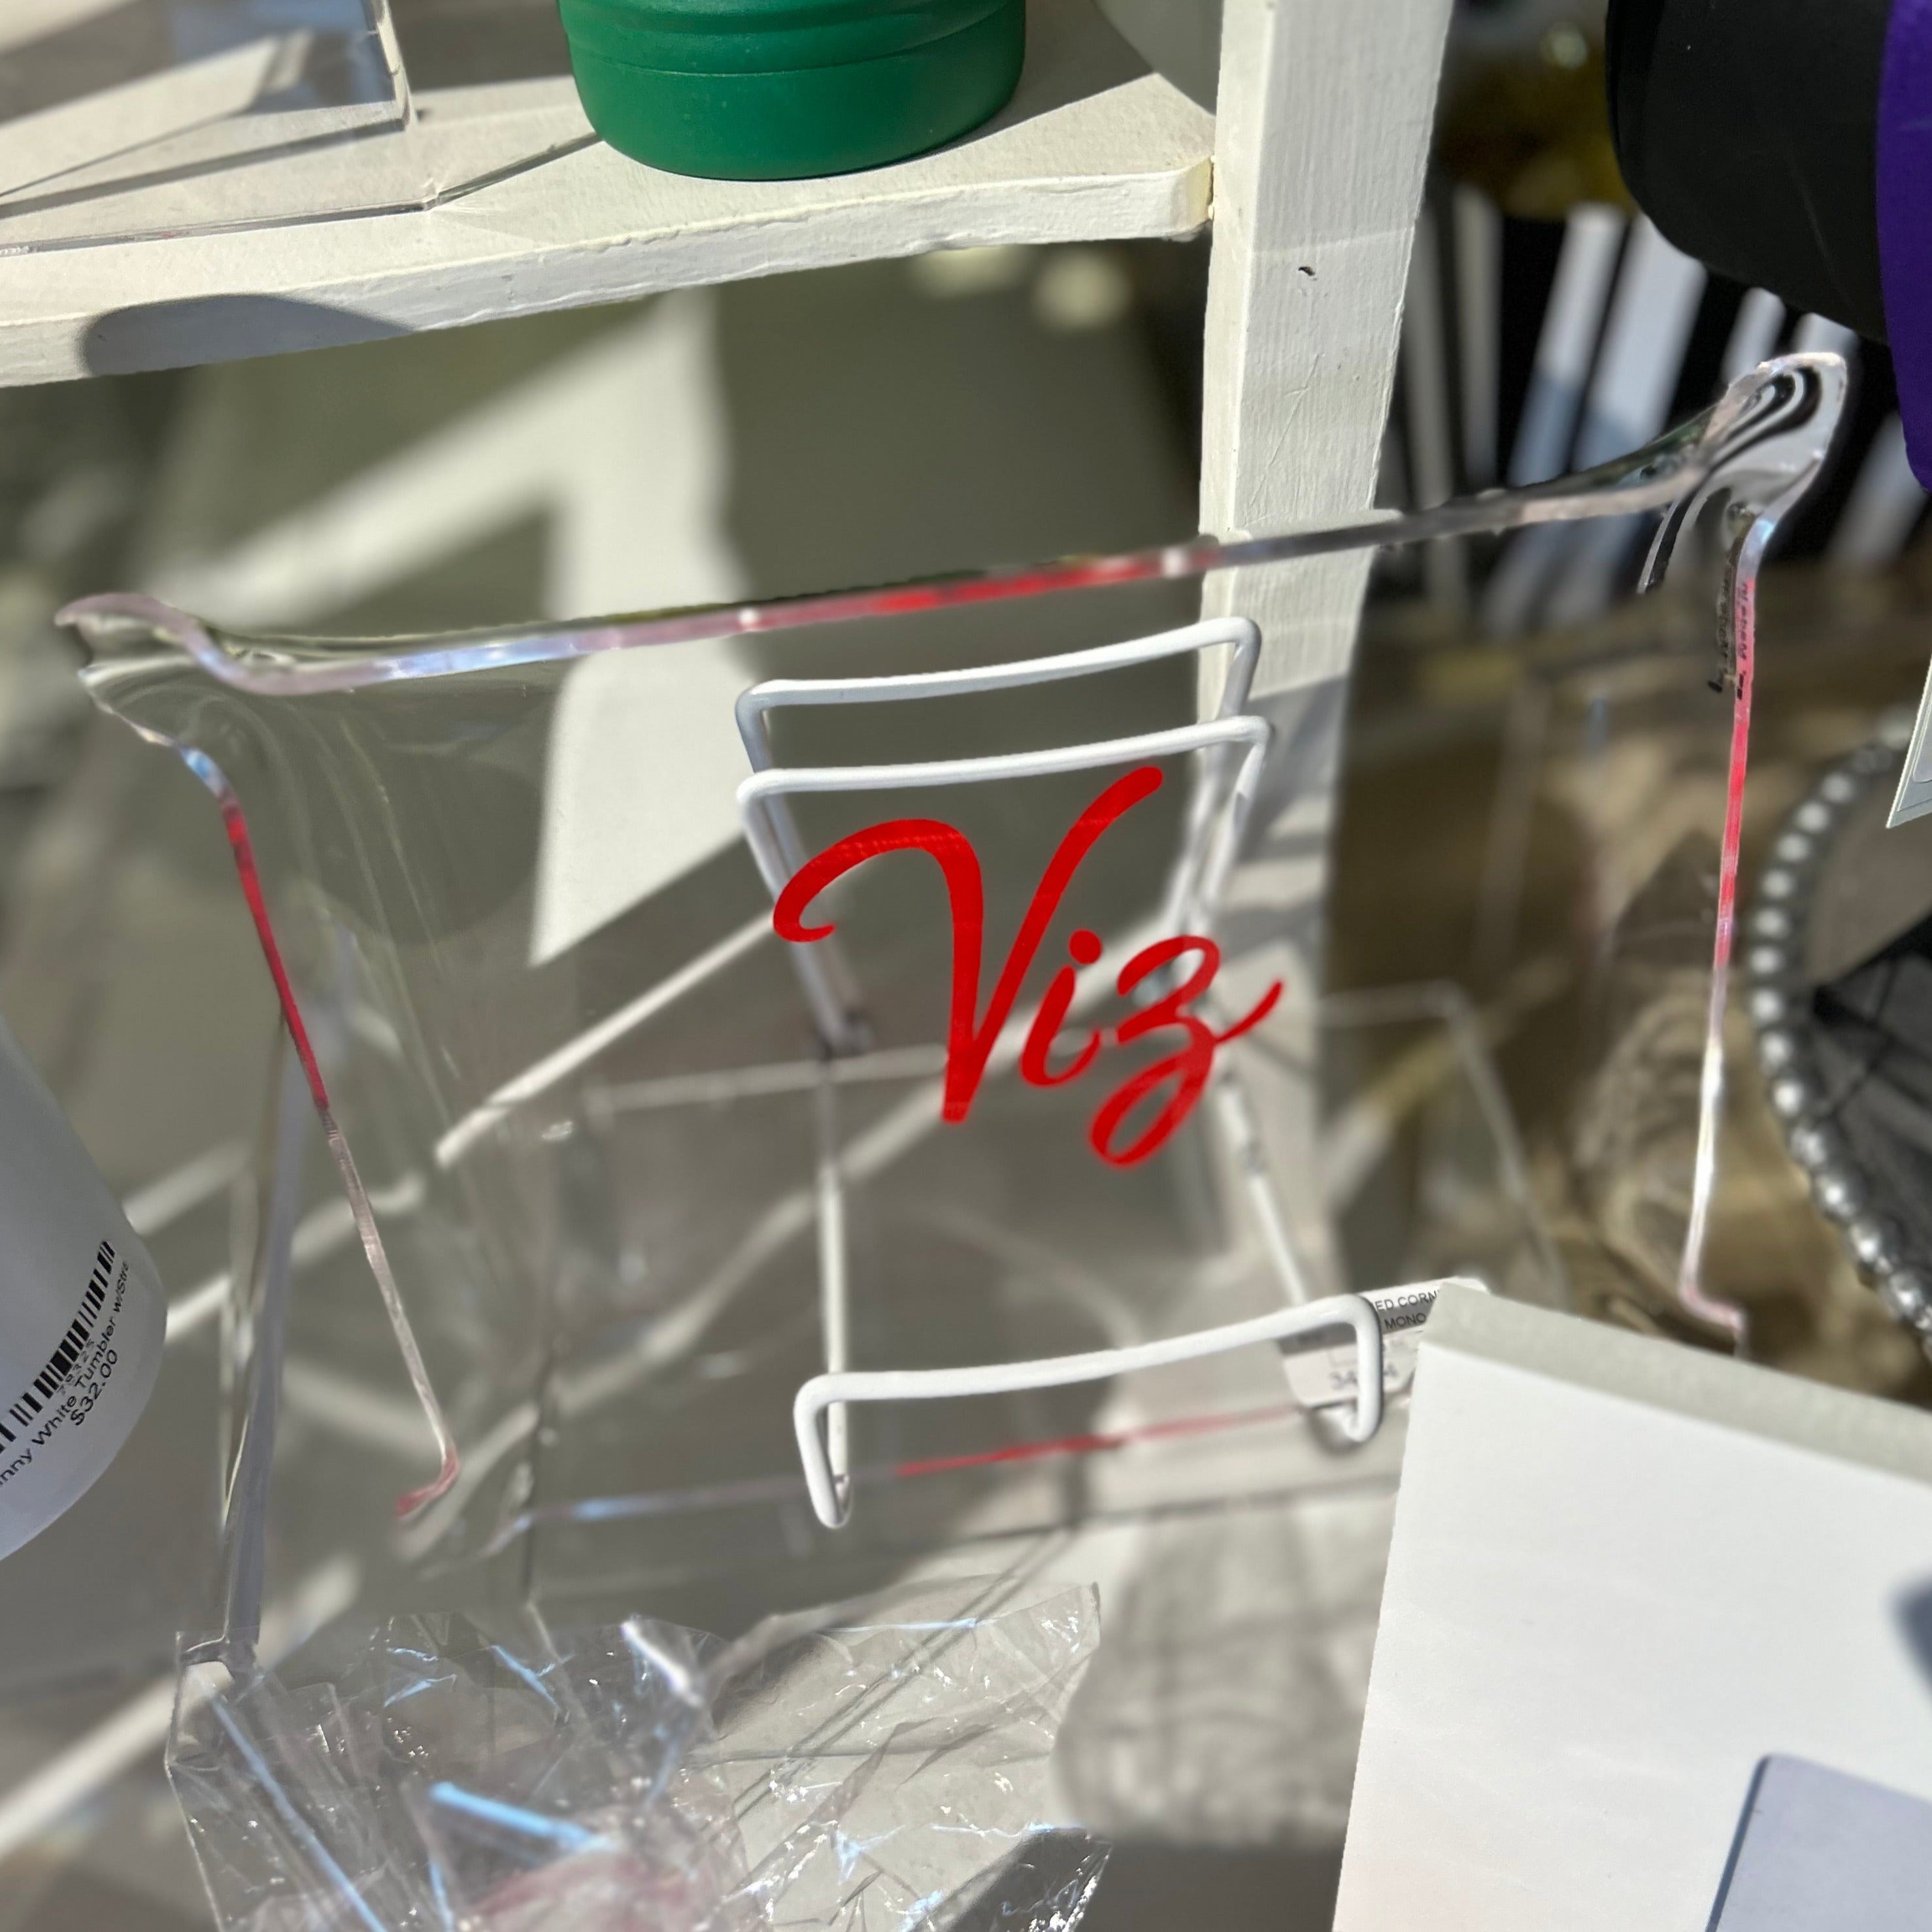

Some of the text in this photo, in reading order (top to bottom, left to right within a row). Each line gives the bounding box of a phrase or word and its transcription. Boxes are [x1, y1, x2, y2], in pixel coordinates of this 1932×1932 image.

[773, 766, 1284, 1168] Viz
[1384, 1312, 1427, 1329] MONO
[1398, 1290, 1440, 1307] CORN
[0, 1448, 32, 1487] nny
[31, 1396, 76, 1445] White
[75, 1316, 116, 1388] Tumbler
[70, 1349, 118, 1425] $32.00
